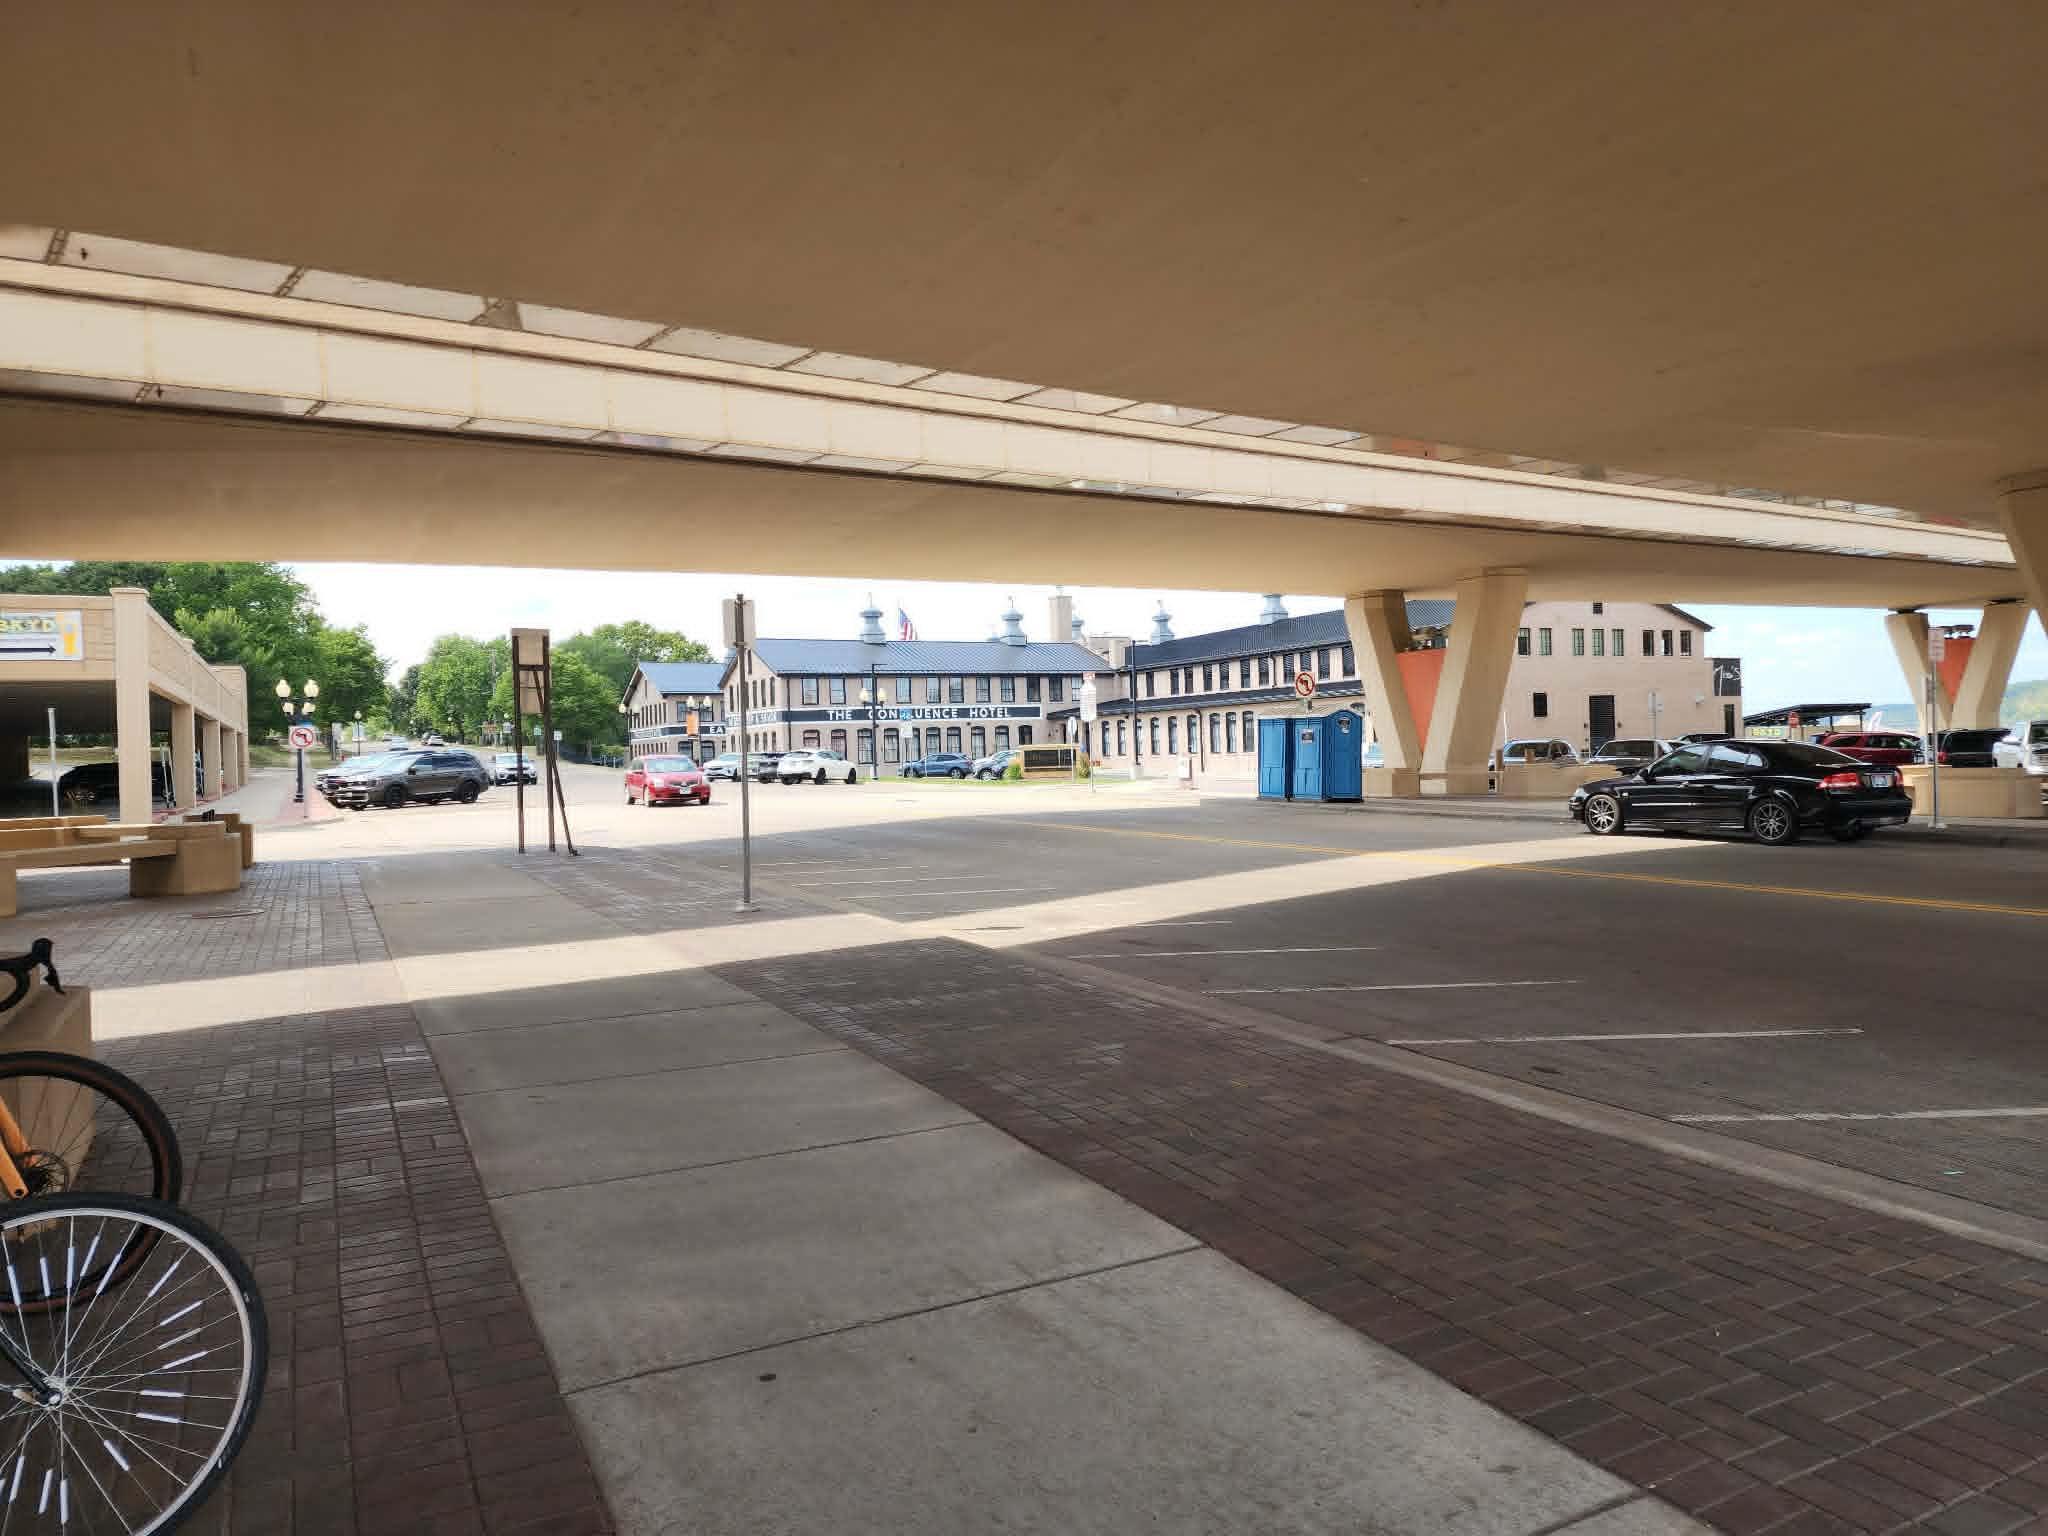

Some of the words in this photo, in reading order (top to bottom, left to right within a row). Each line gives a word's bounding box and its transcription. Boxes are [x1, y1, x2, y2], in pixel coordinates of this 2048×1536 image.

[827, 710, 853, 720] THE
[868, 708, 958, 720] CONUENCE
[969, 707, 1010, 718] HOTEL
